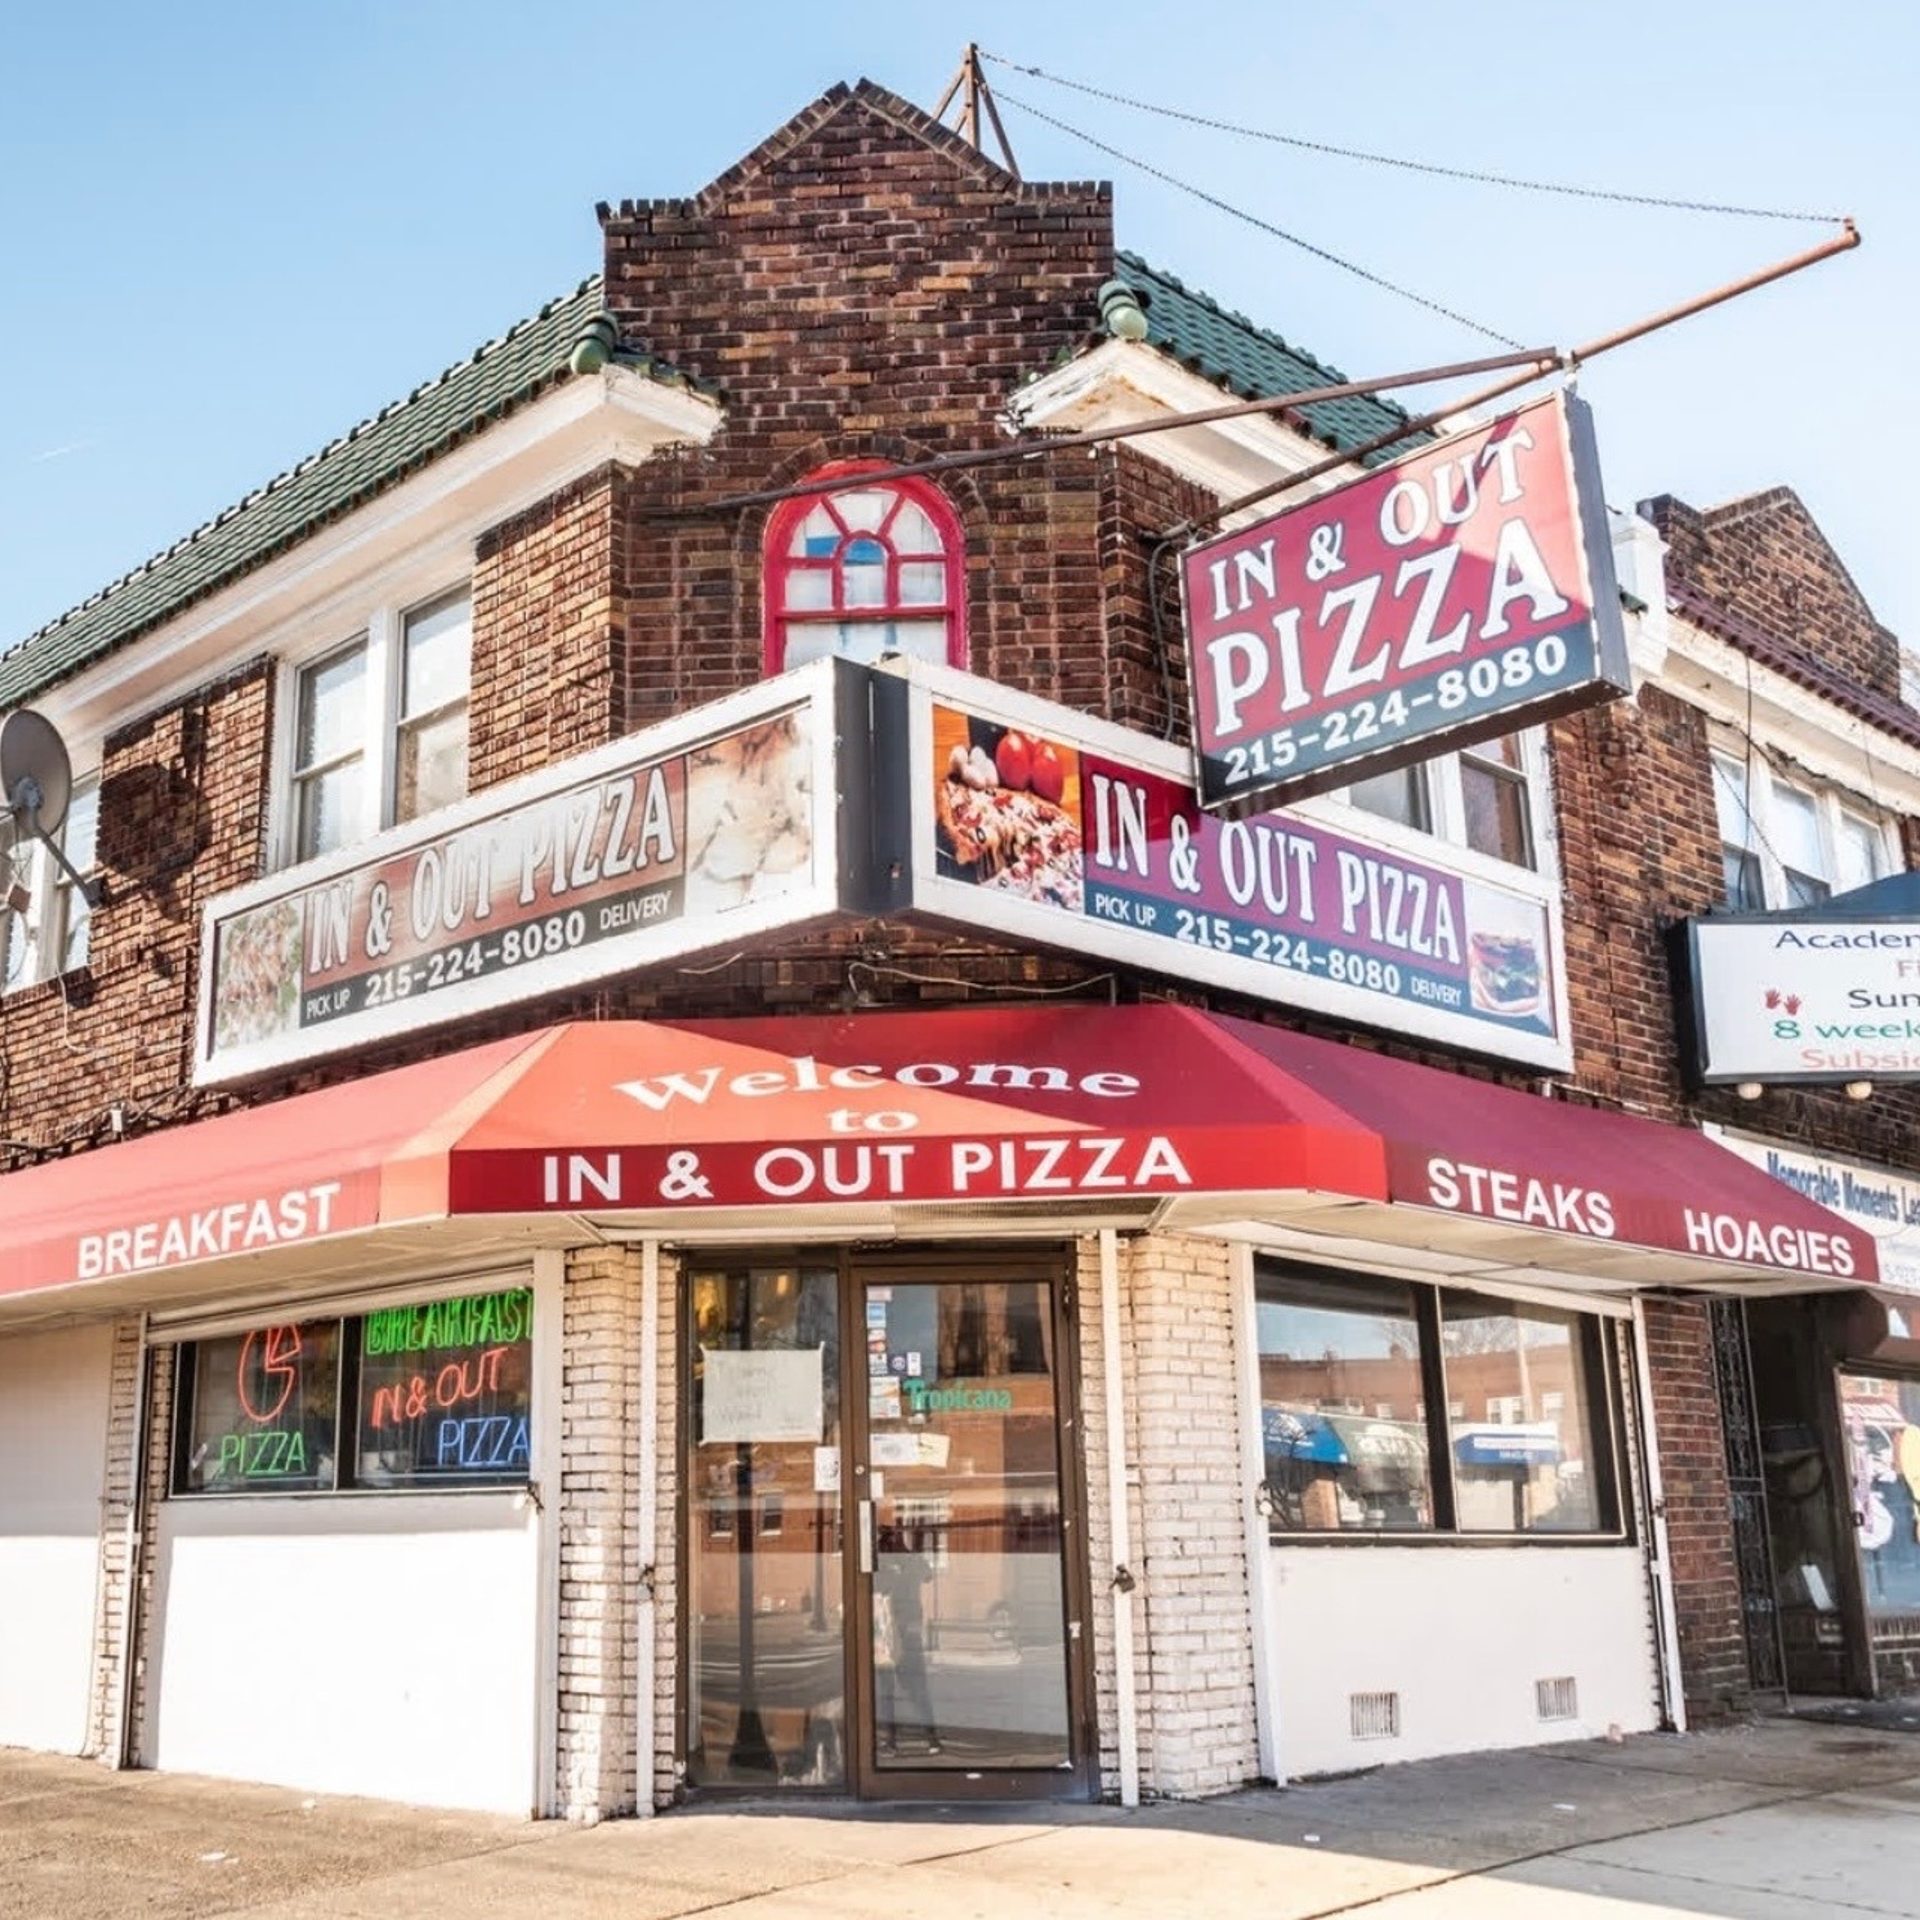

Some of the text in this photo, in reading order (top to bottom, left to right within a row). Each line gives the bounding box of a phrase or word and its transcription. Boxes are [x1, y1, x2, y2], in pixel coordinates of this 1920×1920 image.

[1209, 429, 1534, 620] IN & OUT
[1207, 518, 1569, 737] PIZZA
[1224, 635, 1567, 785] 215-224-8080
[309, 768, 676, 974] IN & OUT PIZZA
[1092, 774, 1461, 964] IN & OUT PIZZA
[306, 890, 673, 1020] PICK UP 215-224-8080 DELIVERY
[1095, 893, 1463, 1007] PICK UP 215-224-8080 DELIVERY
[1774, 1020, 1801, 1039] 8
[611, 1055, 1140, 1112] Welcome
[825, 1107, 919, 1133] to
[543, 1137, 1192, 1203] IN & OUT PIZZA
[1427, 1158, 1616, 1238] STEAKS
[1841, 1171, 1899, 1222] Moments
[78, 1182, 341, 1278] BREAKFAST
[1684, 1208, 1855, 1277] HOAGIES
[366, 1287, 533, 1355] BREAKFAST
[372, 1347, 509, 1429] IN & OUT
[902, 1377, 1013, 1413] Tropicana
[220, 1431, 307, 1476] PIZZA
[438, 1416, 533, 1468] PIZZA
